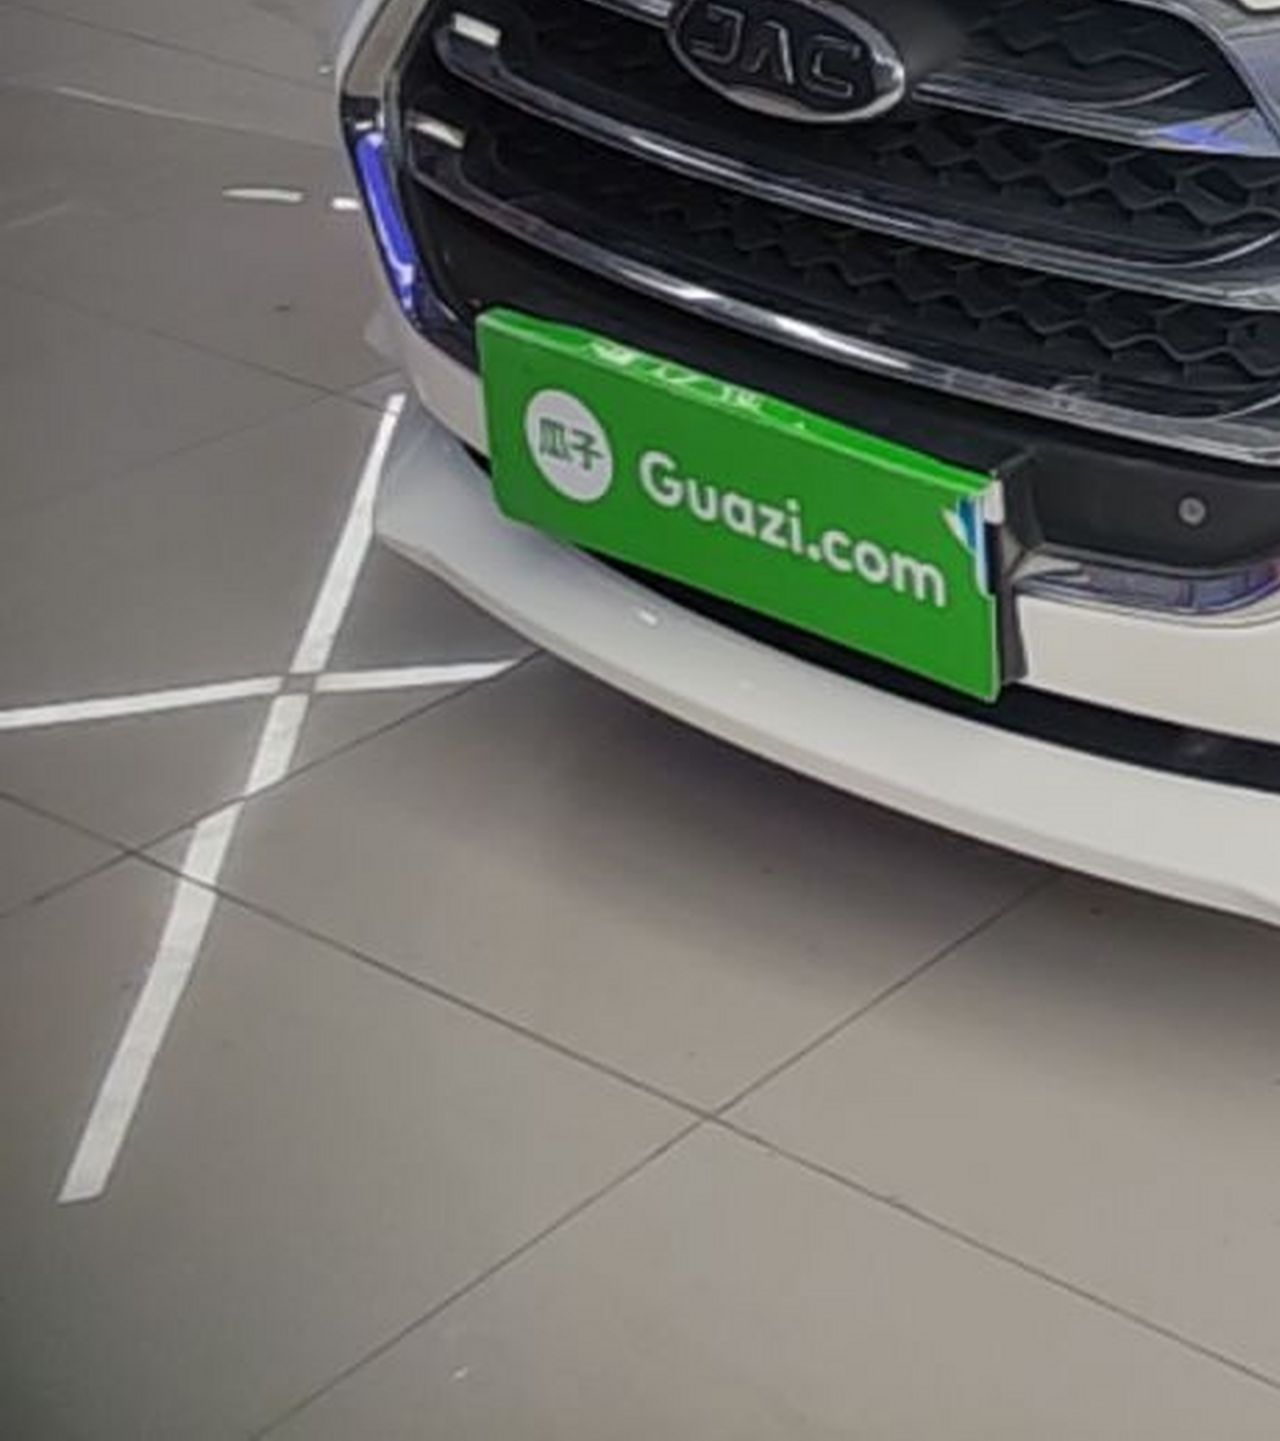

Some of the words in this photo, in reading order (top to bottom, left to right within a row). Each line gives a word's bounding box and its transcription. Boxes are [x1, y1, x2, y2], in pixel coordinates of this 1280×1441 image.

[689, 4, 862, 99] JAC
[537, 417, 605, 474] 瓜子
[638, 451, 946, 608] Guazi.com
